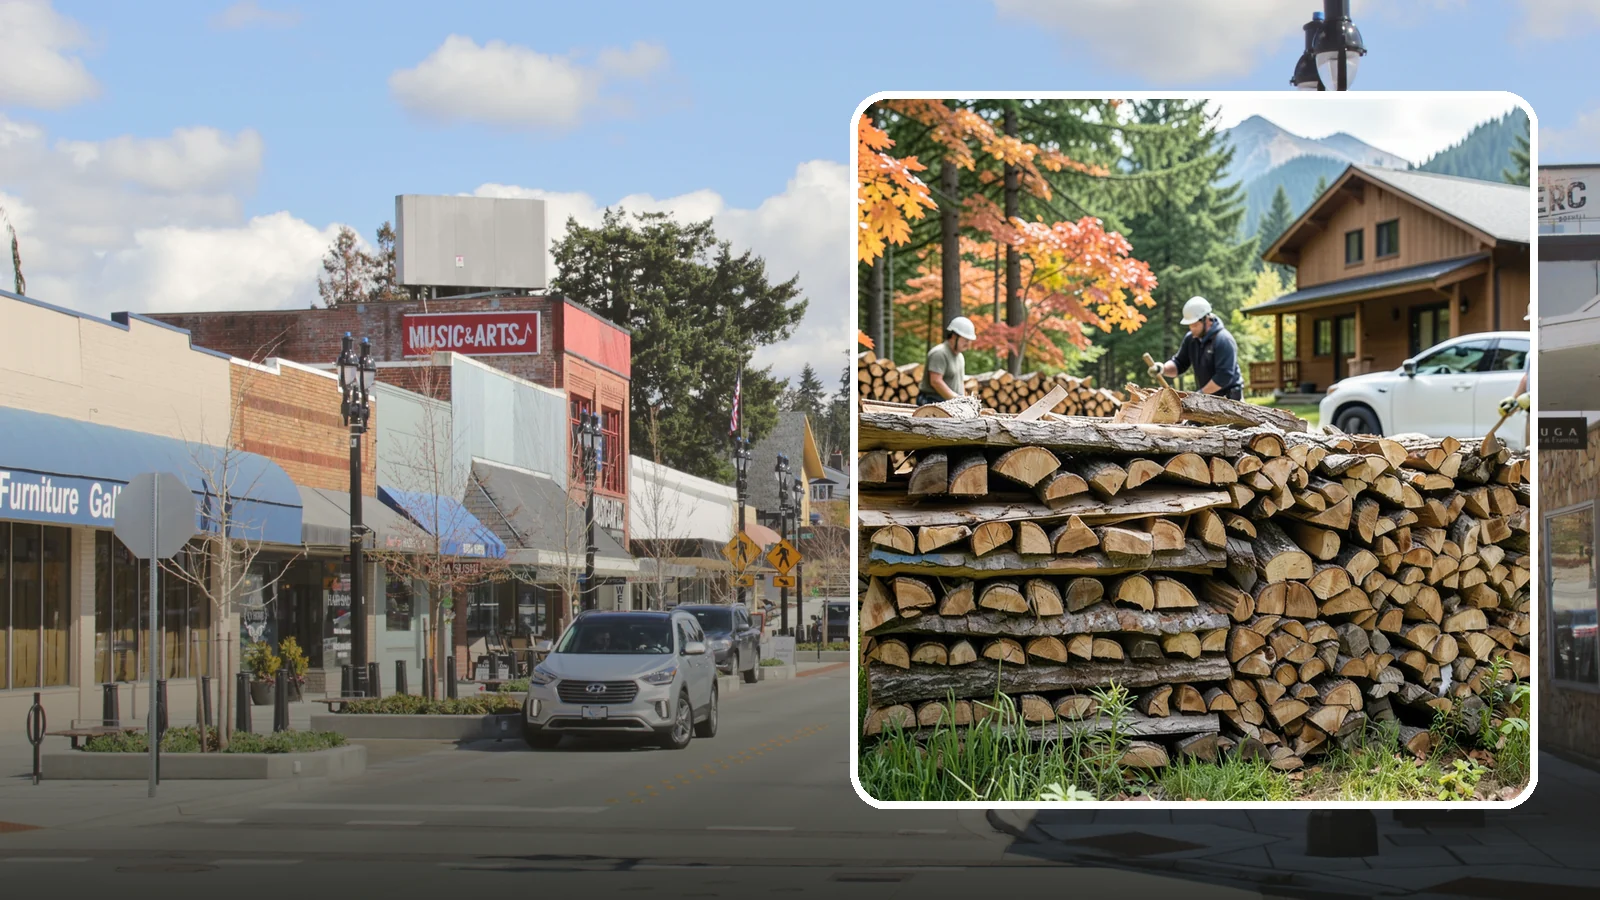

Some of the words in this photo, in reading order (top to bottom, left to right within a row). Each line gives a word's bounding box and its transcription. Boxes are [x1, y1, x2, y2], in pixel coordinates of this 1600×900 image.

[408, 322, 520, 349] MUSIC&ARTS
[1540, 428, 1577, 436] UGA
[0, 472, 79, 515] Furniture
[453, 562, 479, 574] SUSHI
